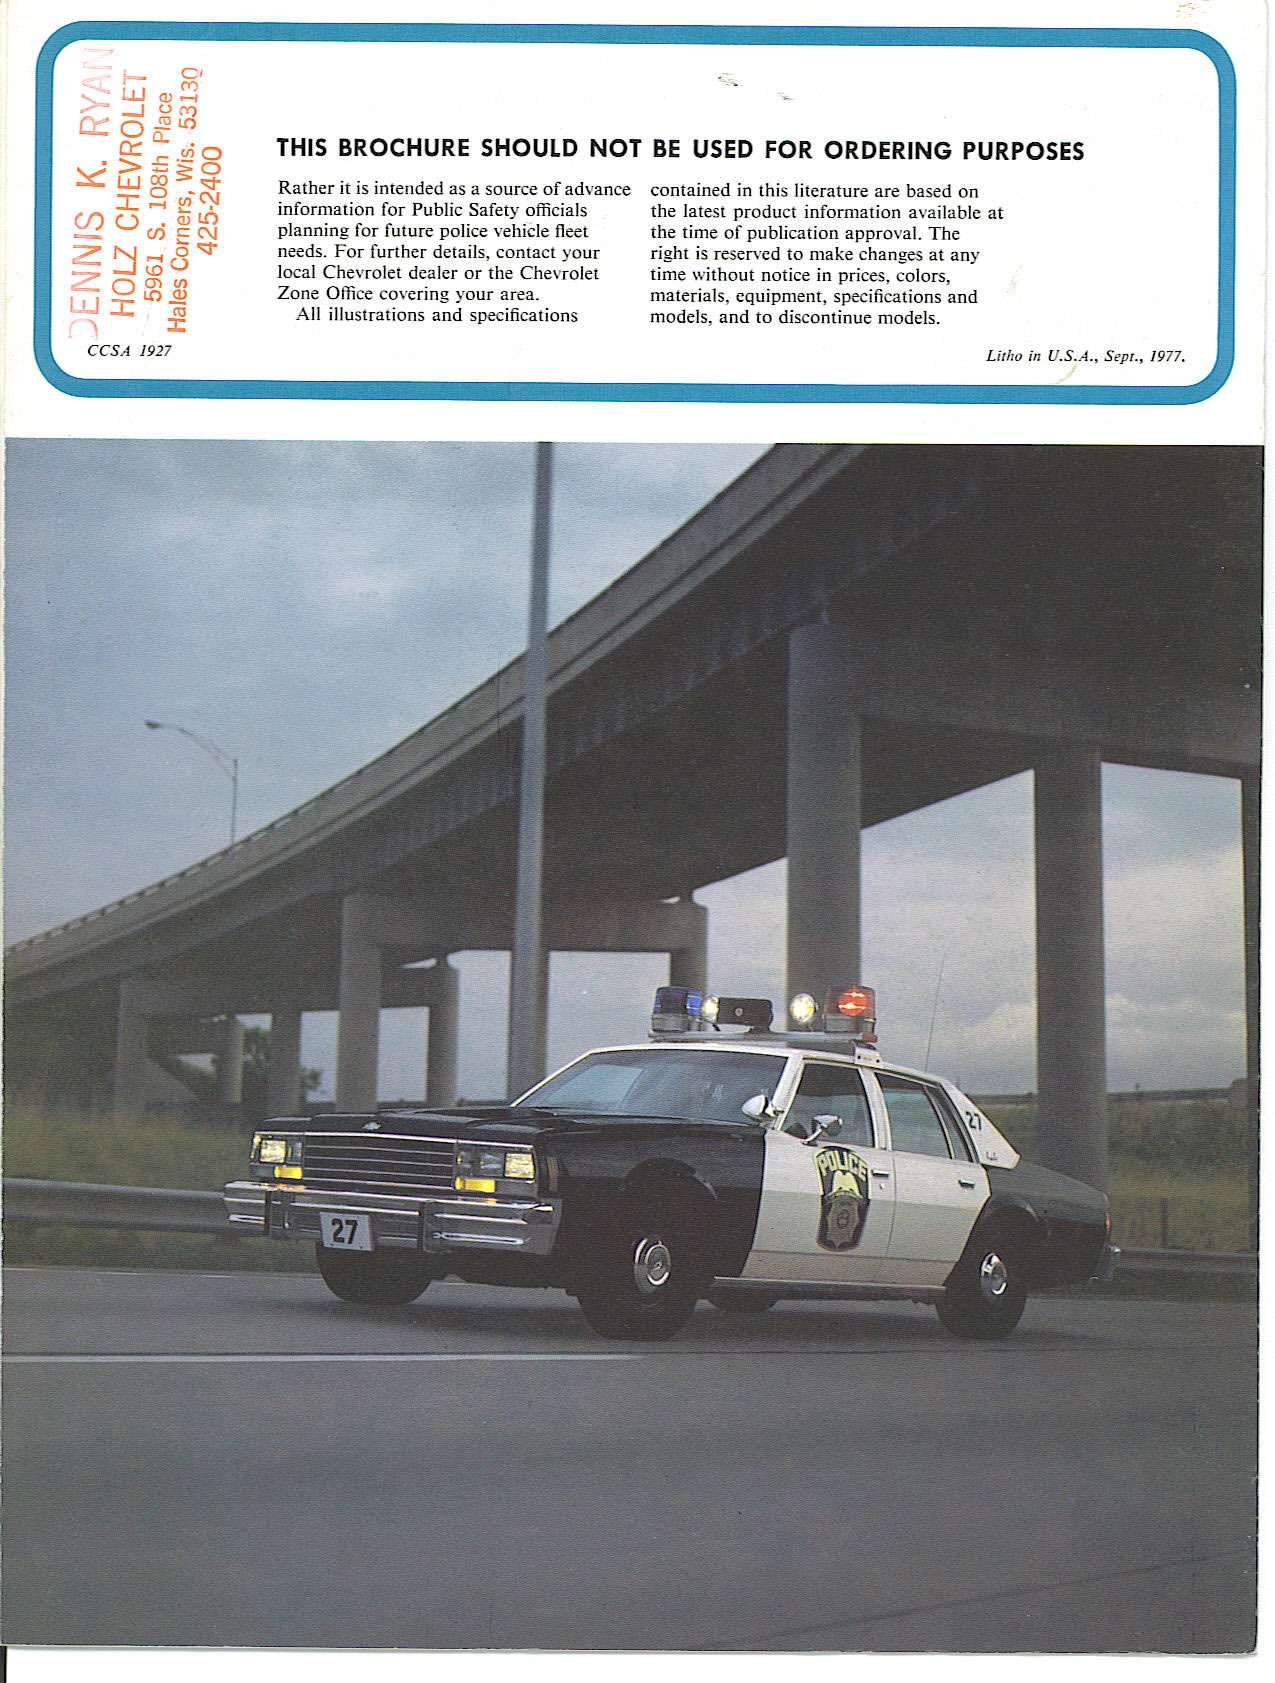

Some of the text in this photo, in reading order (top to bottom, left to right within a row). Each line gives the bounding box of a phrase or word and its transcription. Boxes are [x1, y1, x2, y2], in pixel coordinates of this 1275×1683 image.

[276, 137, 1085, 161] THIS BROCHURE SHOULD NOT BE USED FOR ORDERING PURPOSES
[68, 48, 114, 341] DENNIS K. RYAN
[110, 68, 147, 318] HOLZ CHEVROLET
[143, 92, 173, 303] 5961 S. 108th Place
[278, 180, 631, 197] Rather it is intended as a source of advance
[650, 182, 979, 199] contained in this literature are based on
[167, 67, 201, 333] Hales Corners, Wis. 53130
[196, 145, 223, 256] 425-2400
[277, 201, 588, 220] information for Public Safety officials
[650, 203, 1004, 222] the latest product information available at
[277, 222, 589, 241] planning for future police vehicle fleet
[650, 224, 960, 243] the time of publication approval. The
[277, 243, 601, 263] needs. For further details, contact your
[650, 245, 980, 265] right is reserved to make changes at any
[277, 264, 600, 281] local Chevrolet dealer or the Chevrolet
[650, 266, 951, 286] time without notice in prices, colors,
[277, 285, 540, 304] Zone Office covering your area.
[650, 287, 978, 307] materials, equipment, specifications and
[295, 306, 578, 325] All illustrations and specifications
[650, 309, 940, 325] models, and to discontinue models.
[87, 344, 172, 357] CCSA 1927
[985, 349, 1186, 365] Litho in U.S.A., Sept., 1977.
[964, 1110, 982, 1131] 27
[816, 1150, 868, 1183] POLICE
[330, 1218, 358, 1245] 27
